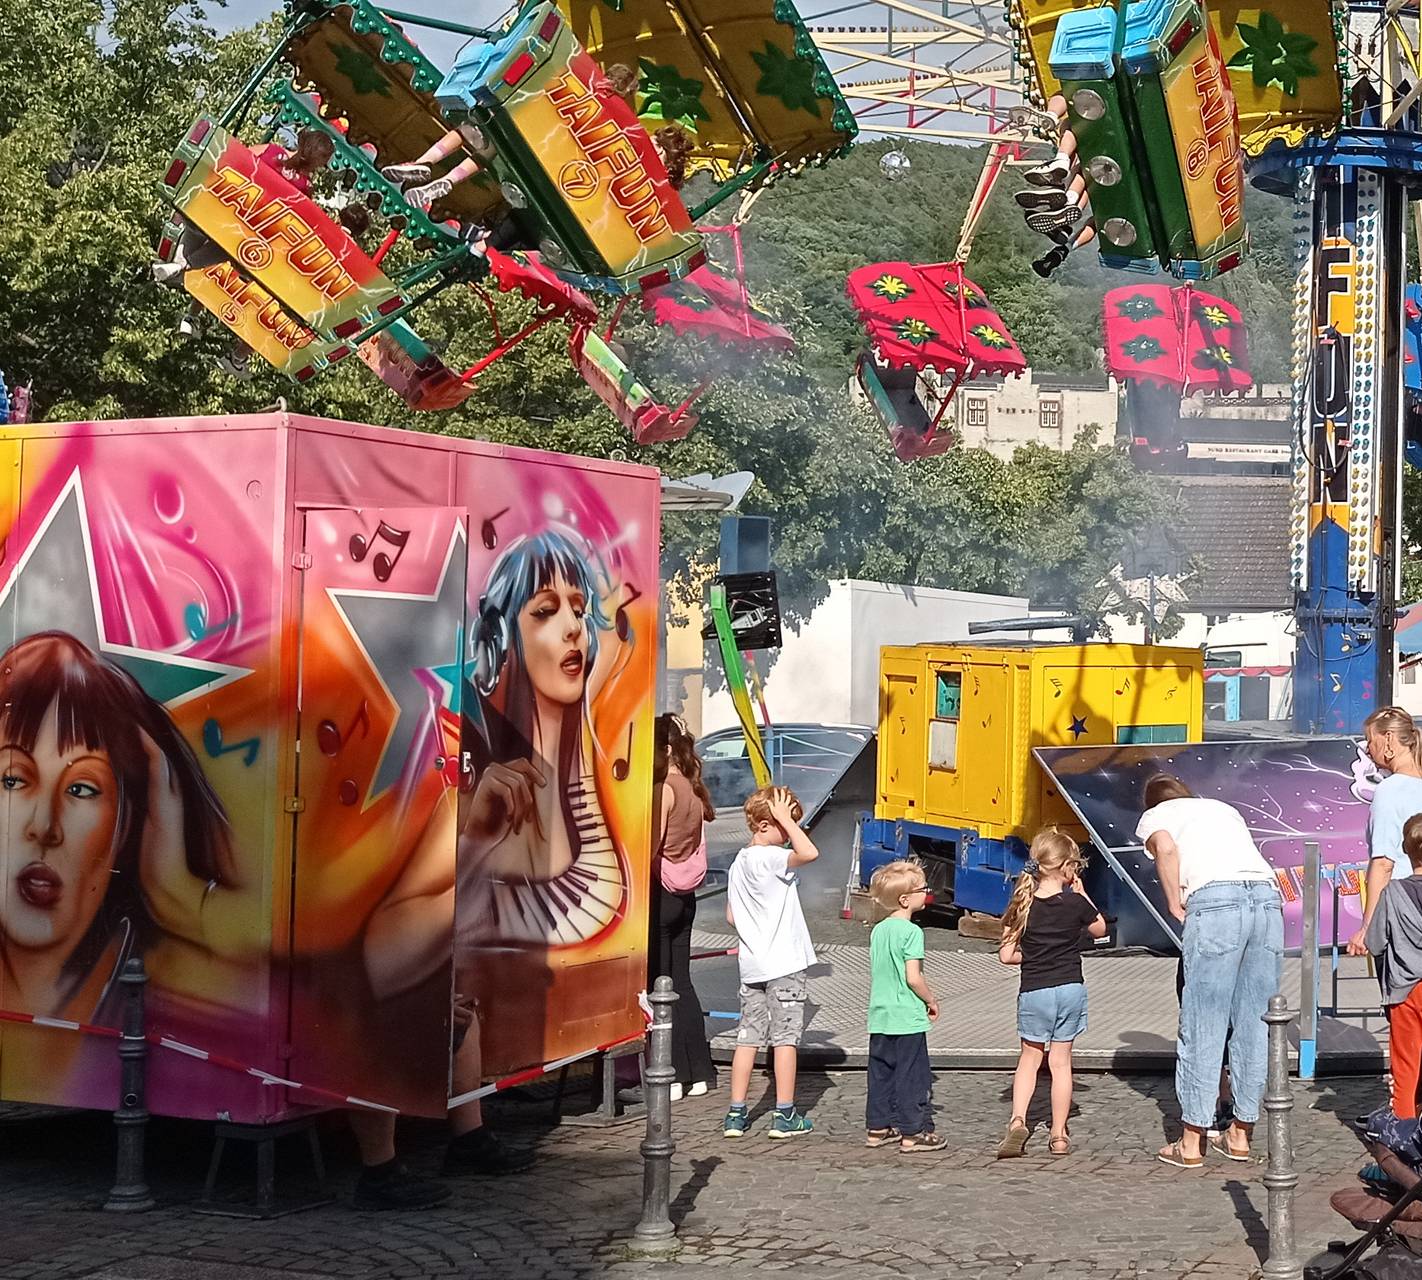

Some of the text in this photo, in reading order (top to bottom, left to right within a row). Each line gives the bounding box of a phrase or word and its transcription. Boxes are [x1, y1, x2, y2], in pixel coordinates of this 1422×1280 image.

[546, 72, 671, 243] TAIFUN
[1186, 140, 1208, 179] 8
[1192, 43, 1240, 231] TAIFUN
[208, 165, 354, 301] TAIFUN
[204, 261, 309, 351] AIFUN
